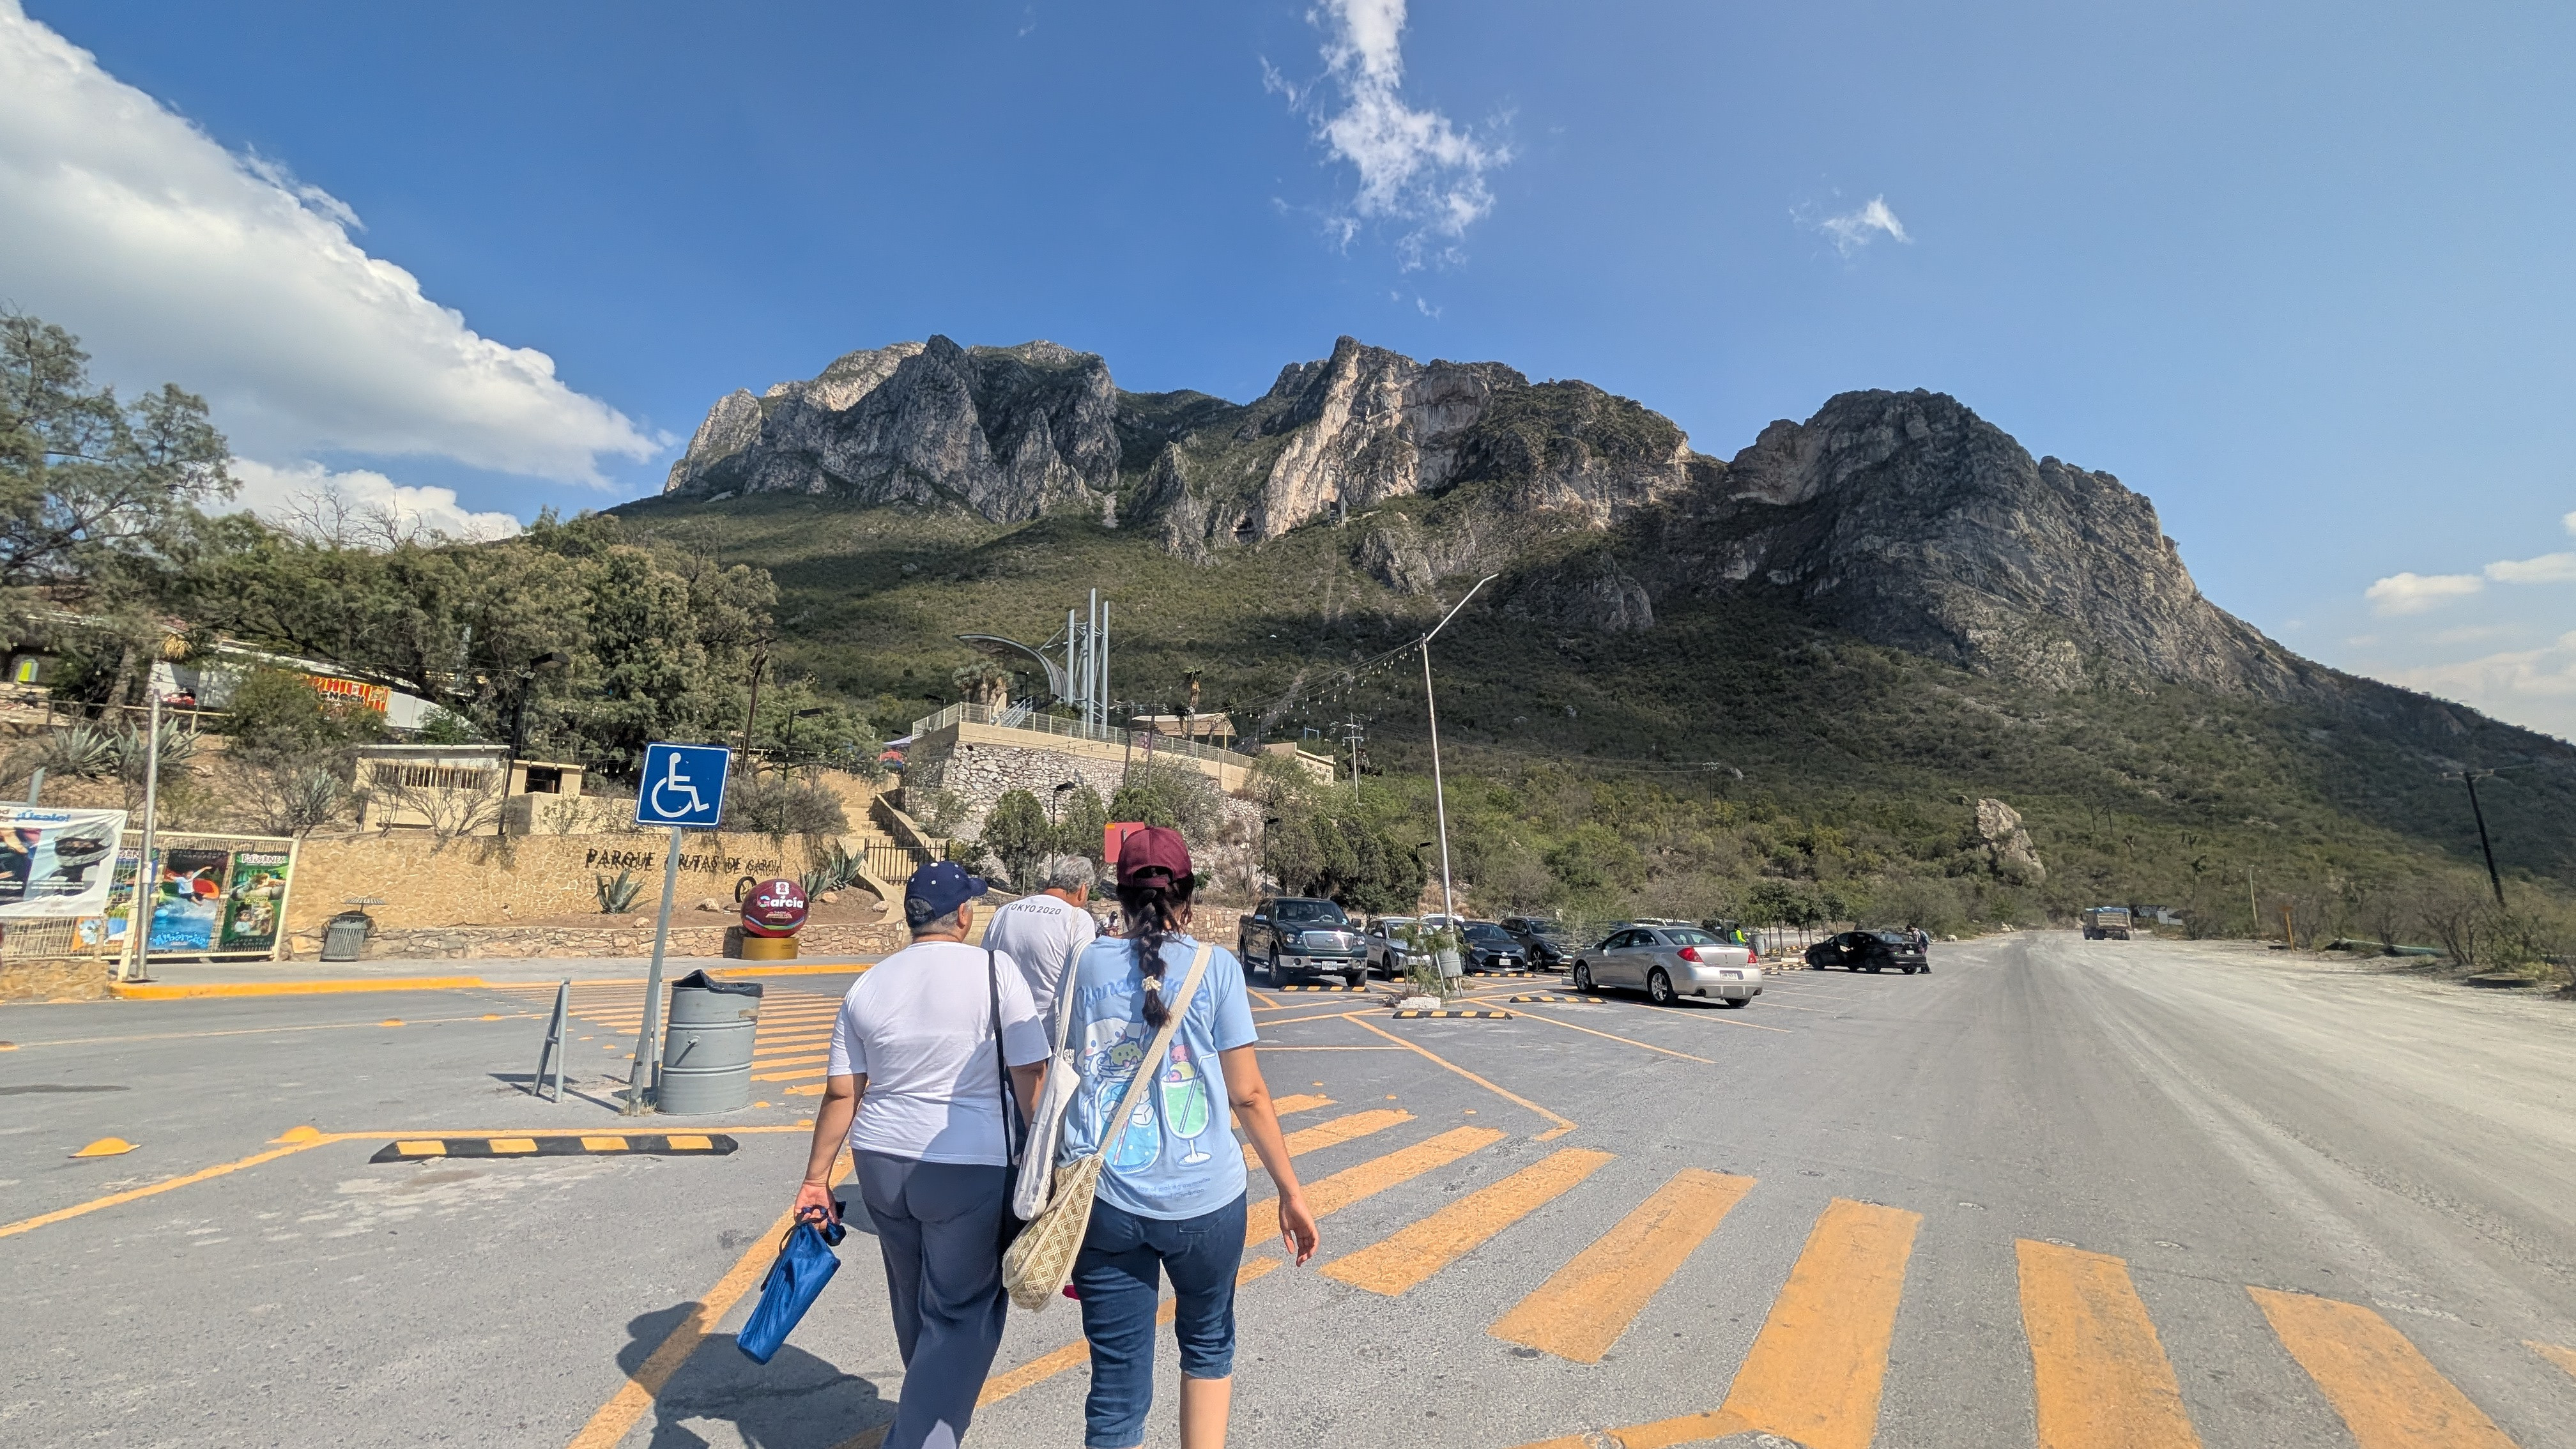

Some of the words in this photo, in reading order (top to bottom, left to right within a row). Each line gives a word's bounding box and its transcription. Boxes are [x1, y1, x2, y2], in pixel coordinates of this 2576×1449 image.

[585, 848, 656, 871] PARQUE
[666, 852, 720, 873] RUTAS
[724, 857, 742, 874] DE
[758, 896, 804, 908] García
[1008, 903, 1036, 912] TOKYO
[1036, 906, 1062, 915] 2020
[1158, 1183, 1181, 1192] making
